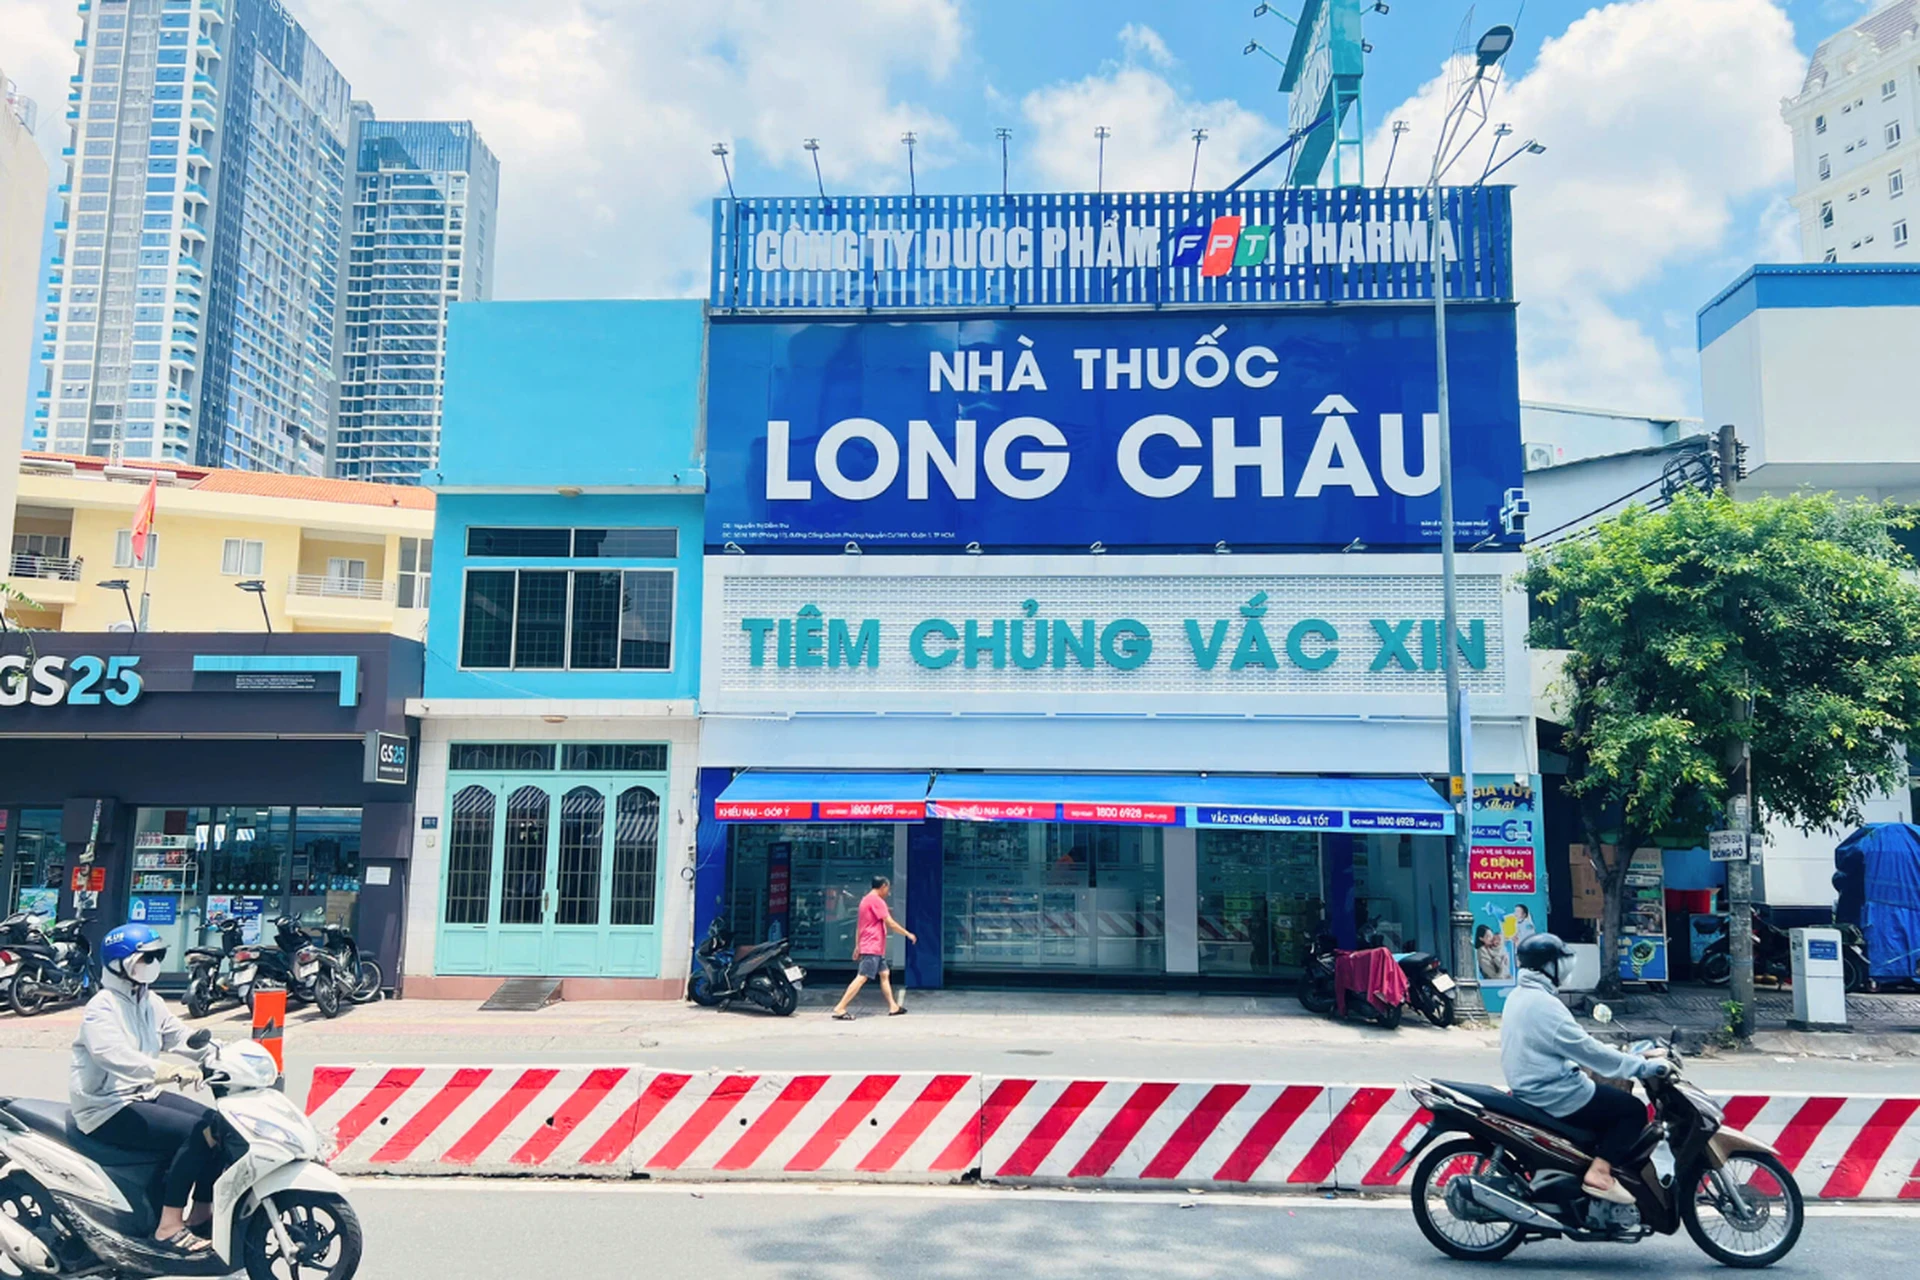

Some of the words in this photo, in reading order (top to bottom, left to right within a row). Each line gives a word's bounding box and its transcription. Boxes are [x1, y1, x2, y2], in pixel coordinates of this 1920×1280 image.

[755, 221, 860, 271] CÔNG
[868, 229, 916, 271] TY
[926, 220, 1033, 275] DƯỢC
[1041, 210, 1160, 269] PHẨM
[1285, 220, 1458, 265] PHARMA
[929, 335, 1047, 392] NHÀ
[1073, 324, 1280, 390] THUỐC
[765, 416, 1071, 500] LONG
[1116, 394, 1444, 499] CHÂU
[742, 604, 881, 669] TIÊM
[909, 598, 1153, 671] CHỦNG
[1184, 590, 1340, 671] VẮC
[1369, 618, 1487, 671] XIN
[0, 654, 143, 706] GS25
[380, 743, 405, 764] GS25
[764, 805, 783, 817] GÓP
[1006, 804, 1026, 816] GÓP
[1096, 806, 1118, 818] 1800
[1119, 806, 1142, 819] 6928
[1210, 812, 1228, 823] VẮC
[1229, 815, 1243, 824] XIN
[1377, 815, 1394, 826] 1800
[1395, 816, 1415, 827] 6928
[1480, 857, 1489, 867] 6
[1490, 855, 1524, 869] BỆNH
[1473, 871, 1503, 880] NGUY
